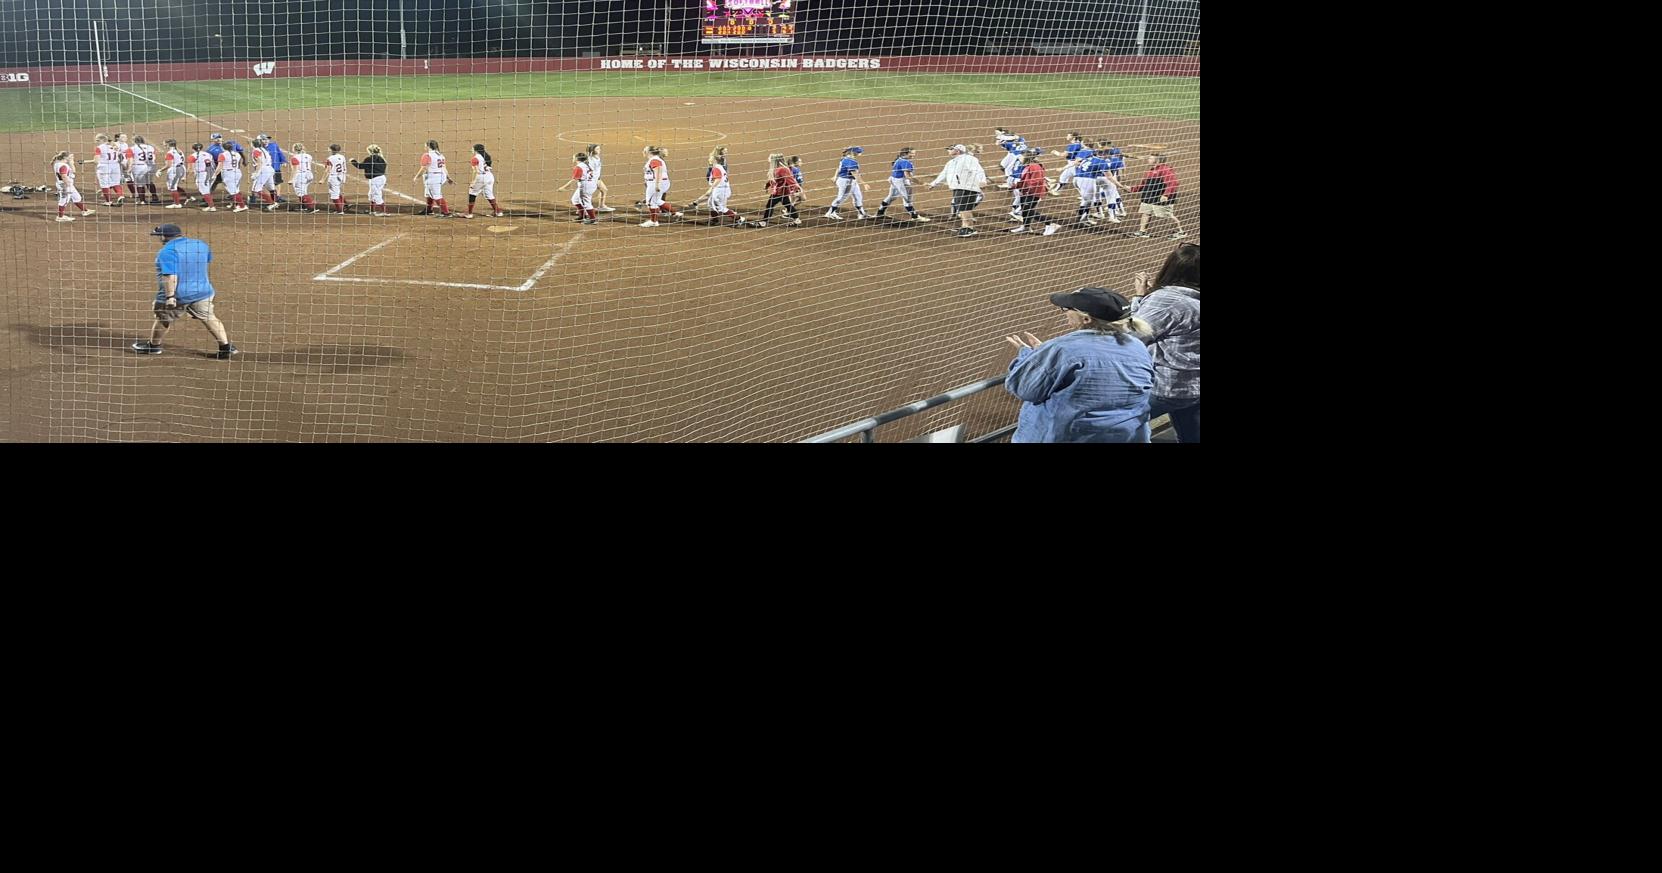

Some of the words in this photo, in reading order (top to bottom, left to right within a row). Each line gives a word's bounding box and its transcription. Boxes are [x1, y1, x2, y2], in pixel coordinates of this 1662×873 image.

[600, 59, 643, 69] HOME
[648, 59, 666, 69] OF
[671, 59, 703, 69] THE
[708, 58, 798, 68] WISCONSIN
[802, 58, 880, 69] BADGERS
